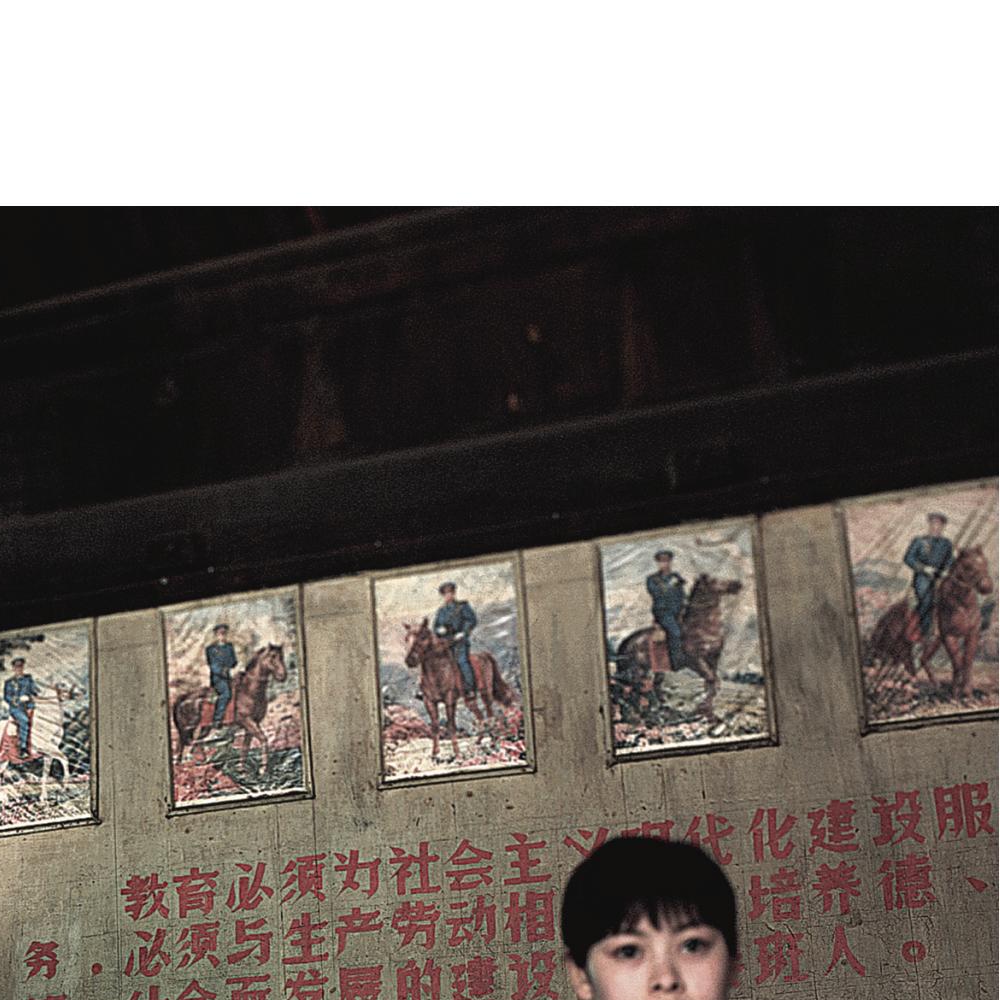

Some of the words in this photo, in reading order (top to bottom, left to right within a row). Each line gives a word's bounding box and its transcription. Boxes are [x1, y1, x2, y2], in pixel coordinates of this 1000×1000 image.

[120, 781, 993, 922] 教育必须为社会主义代化建设服
